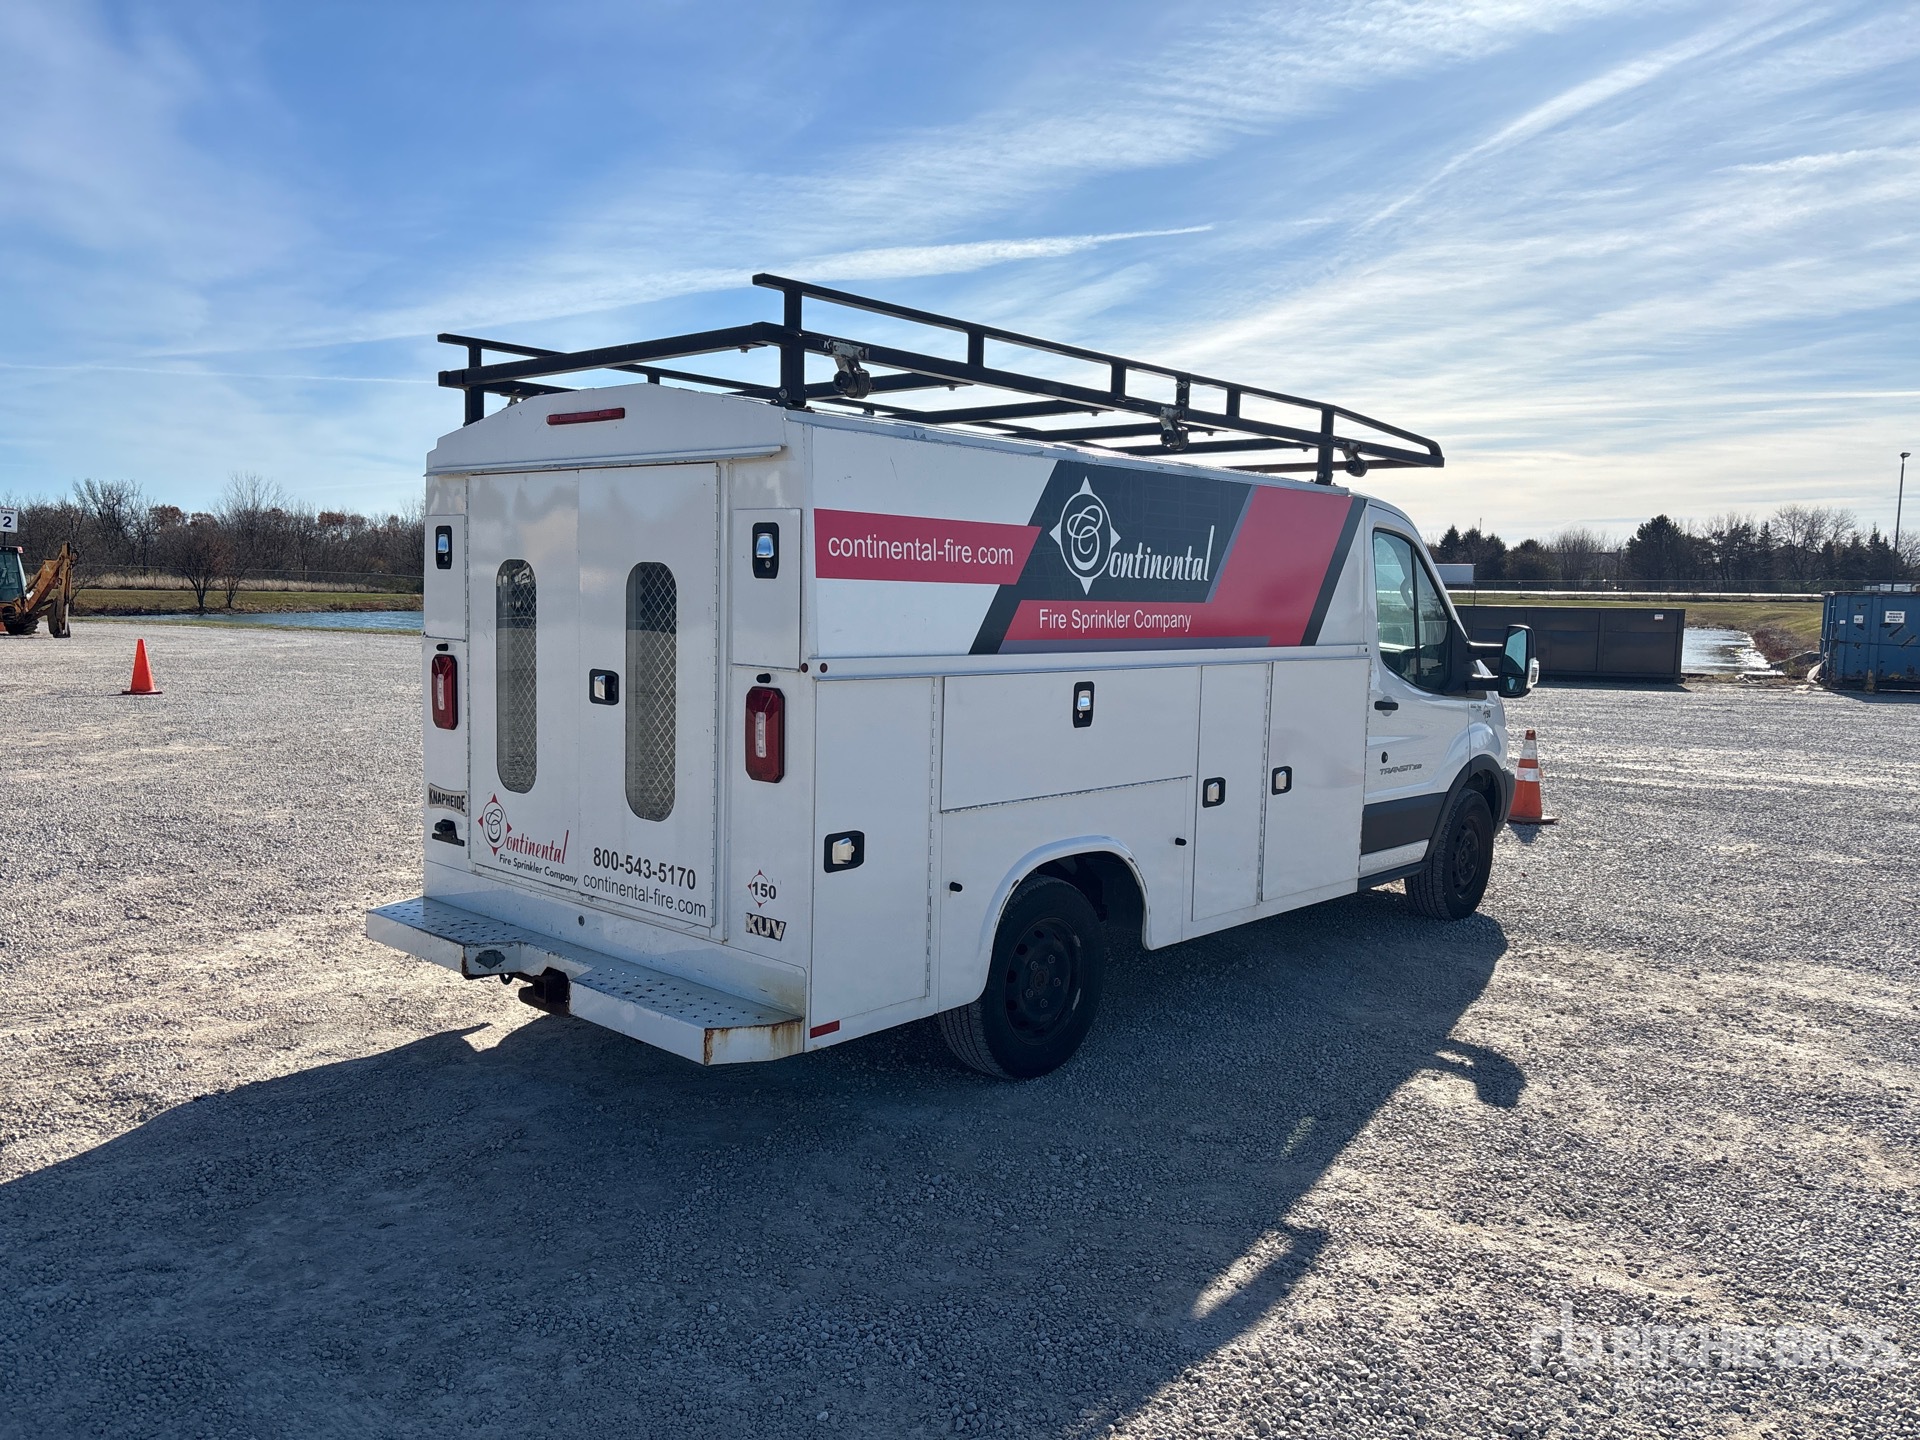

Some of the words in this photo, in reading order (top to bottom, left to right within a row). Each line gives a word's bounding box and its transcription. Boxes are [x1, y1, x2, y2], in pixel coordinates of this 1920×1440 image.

[3, 516, 12, 528] 2
[828, 534, 1014, 565] continental-fire.com
[1039, 608, 1067, 629] Fire
[1071, 608, 1130, 633] Sprinkler
[1134, 609, 1192, 632] Company
[428, 788, 466, 813] KNAPHEIDE
[485, 808, 569, 864] Continental
[499, 853, 512, 866] Fire
[513, 857, 542, 874] Sprinkler
[544, 867, 579, 885] Company
[593, 847, 696, 890] 800-543-5170
[583, 874, 706, 918] continental-fire.com
[752, 881, 777, 900] 150
[746, 912, 787, 941] KUV
